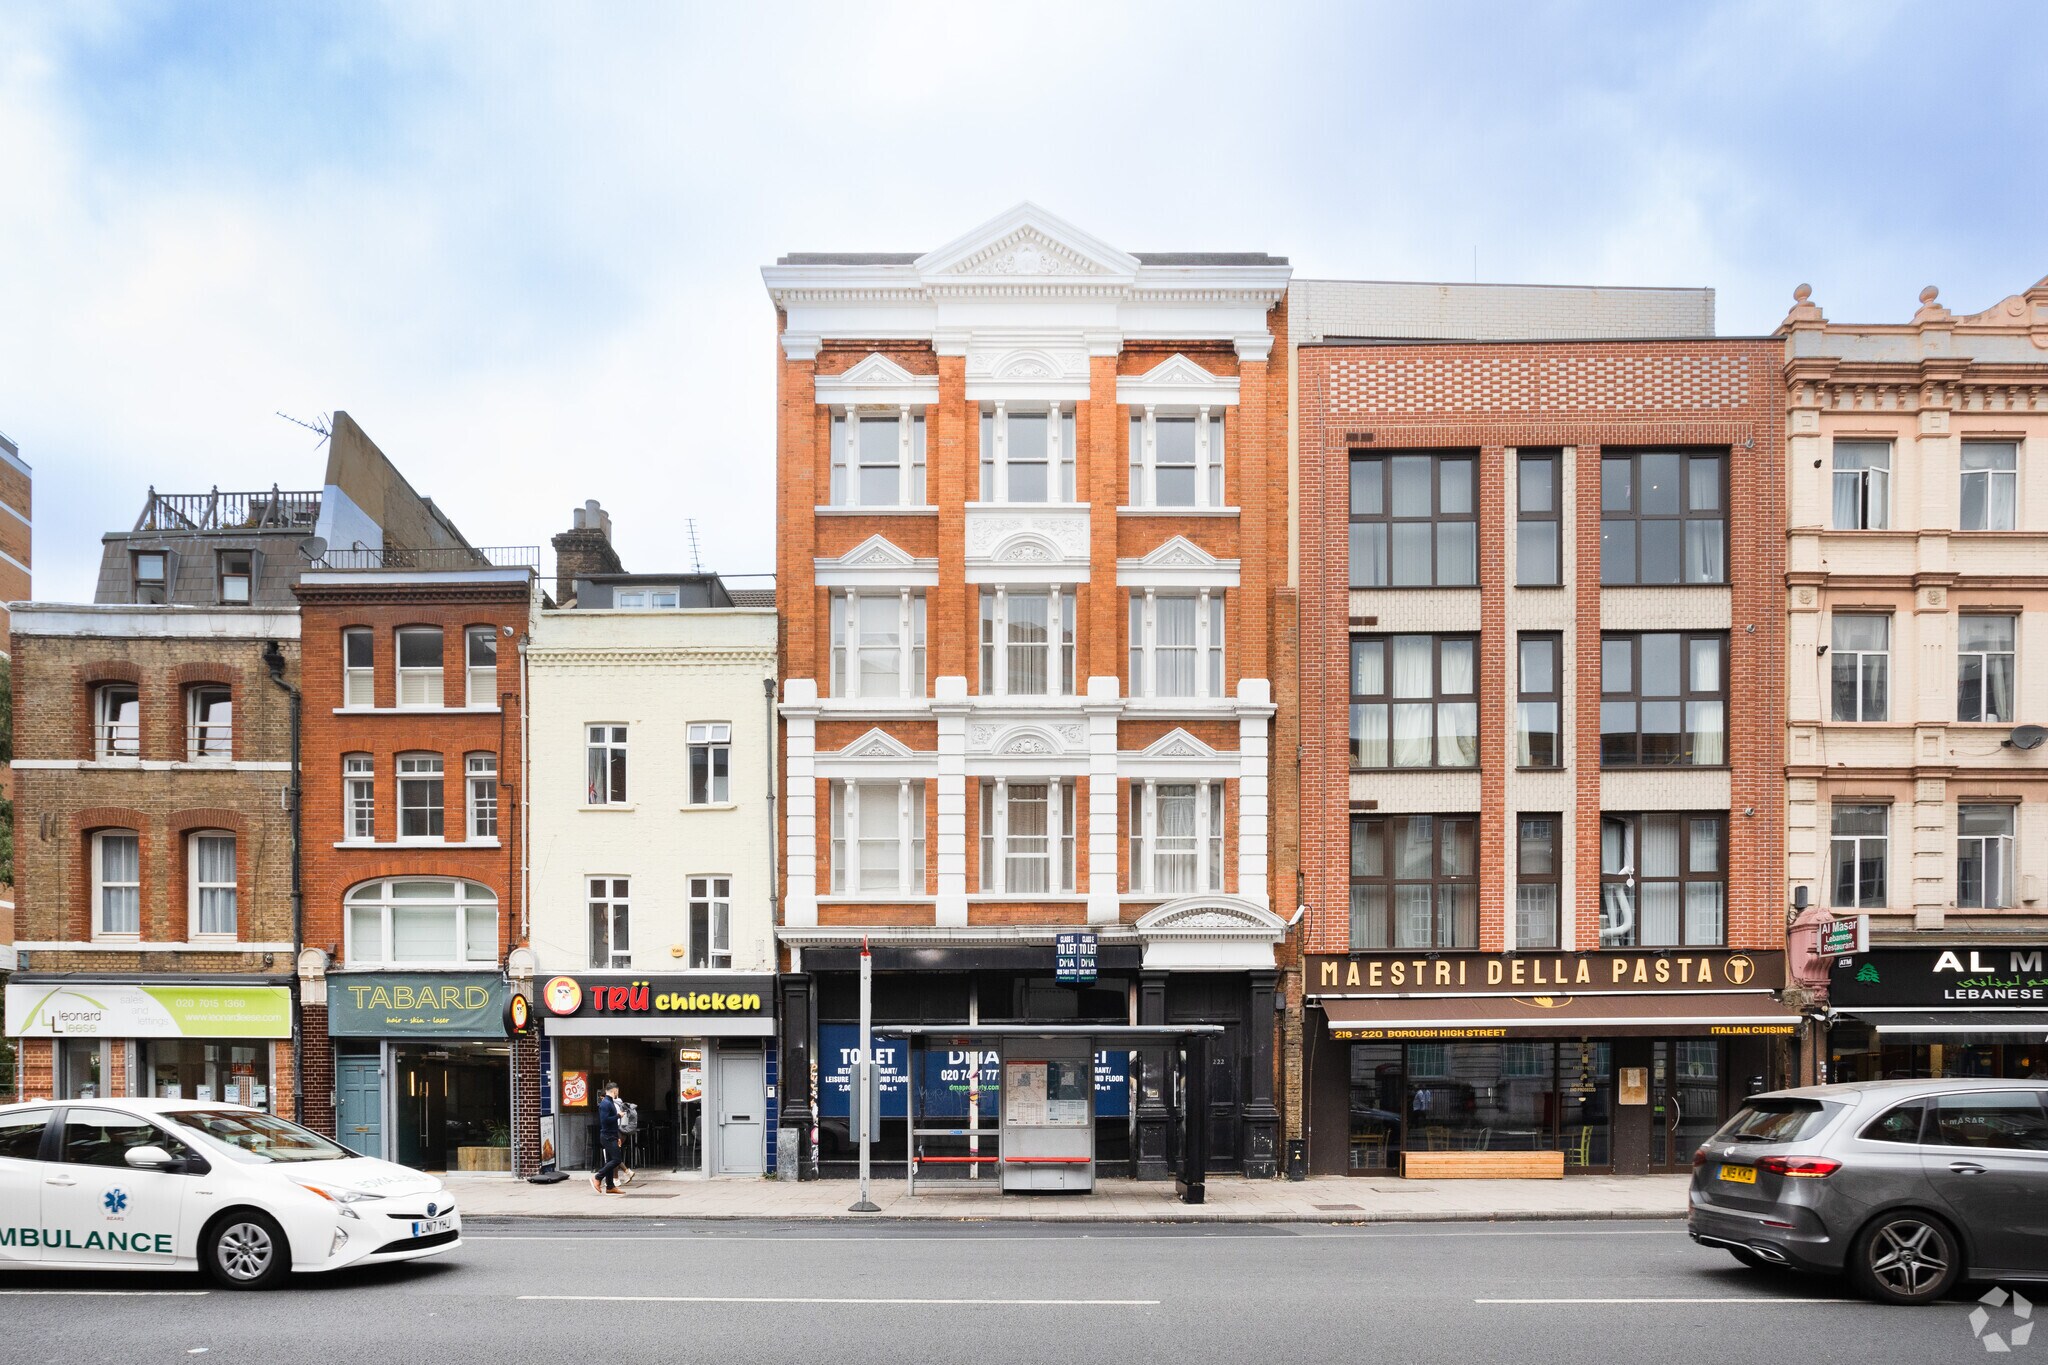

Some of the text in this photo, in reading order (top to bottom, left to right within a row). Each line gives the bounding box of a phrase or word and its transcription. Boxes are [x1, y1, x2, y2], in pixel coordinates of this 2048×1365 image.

[1821, 921, 1857, 934] Al Masar
[1825, 933, 1853, 943] Lebanese
[1057, 944, 1077, 954] TO LET
[1079, 944, 1097, 954] TO LET
[1823, 941, 1855, 952] Restaurant
[1059, 958, 1075, 967] DMA
[1081, 958, 1095, 967] DMA
[1932, 951, 2042, 972] AL M
[1321, 958, 1713, 987] MAESTRI DELLA PASTA
[348, 986, 489, 1010] TABARD
[1944, 989, 2044, 999] LEBANESE
[120, 995, 144, 1004] sales
[176, 999, 246, 1008] 020 7015 1360
[655, 992, 761, 1011] chicken
[58, 1010, 102, 1021] leonard
[131, 1006, 149, 1015] and
[137, 1016, 169, 1027] lettings
[185, 1013, 282, 1023] www.leonardleese.com
[386, 1016, 402, 1024] hair
[410, 1016, 425, 1024] skin
[432, 1016, 450, 1024] laser
[65, 1022, 97, 1033] leese
[1711, 1026, 1794, 1034] ITALIAN CUISINE
[1335, 1031, 1353, 1039] 218
[1361, 1030, 1383, 1038] 220
[1387, 1030, 1438, 1039] BOROUGH
[1439, 1029, 1465, 1038] HIGH
[1466, 1029, 1507, 1038] STREET
[840, 1048, 860, 1065] TO
[941, 1070, 958, 1080] 020
[0, 1227, 173, 1253] MBULANCE
